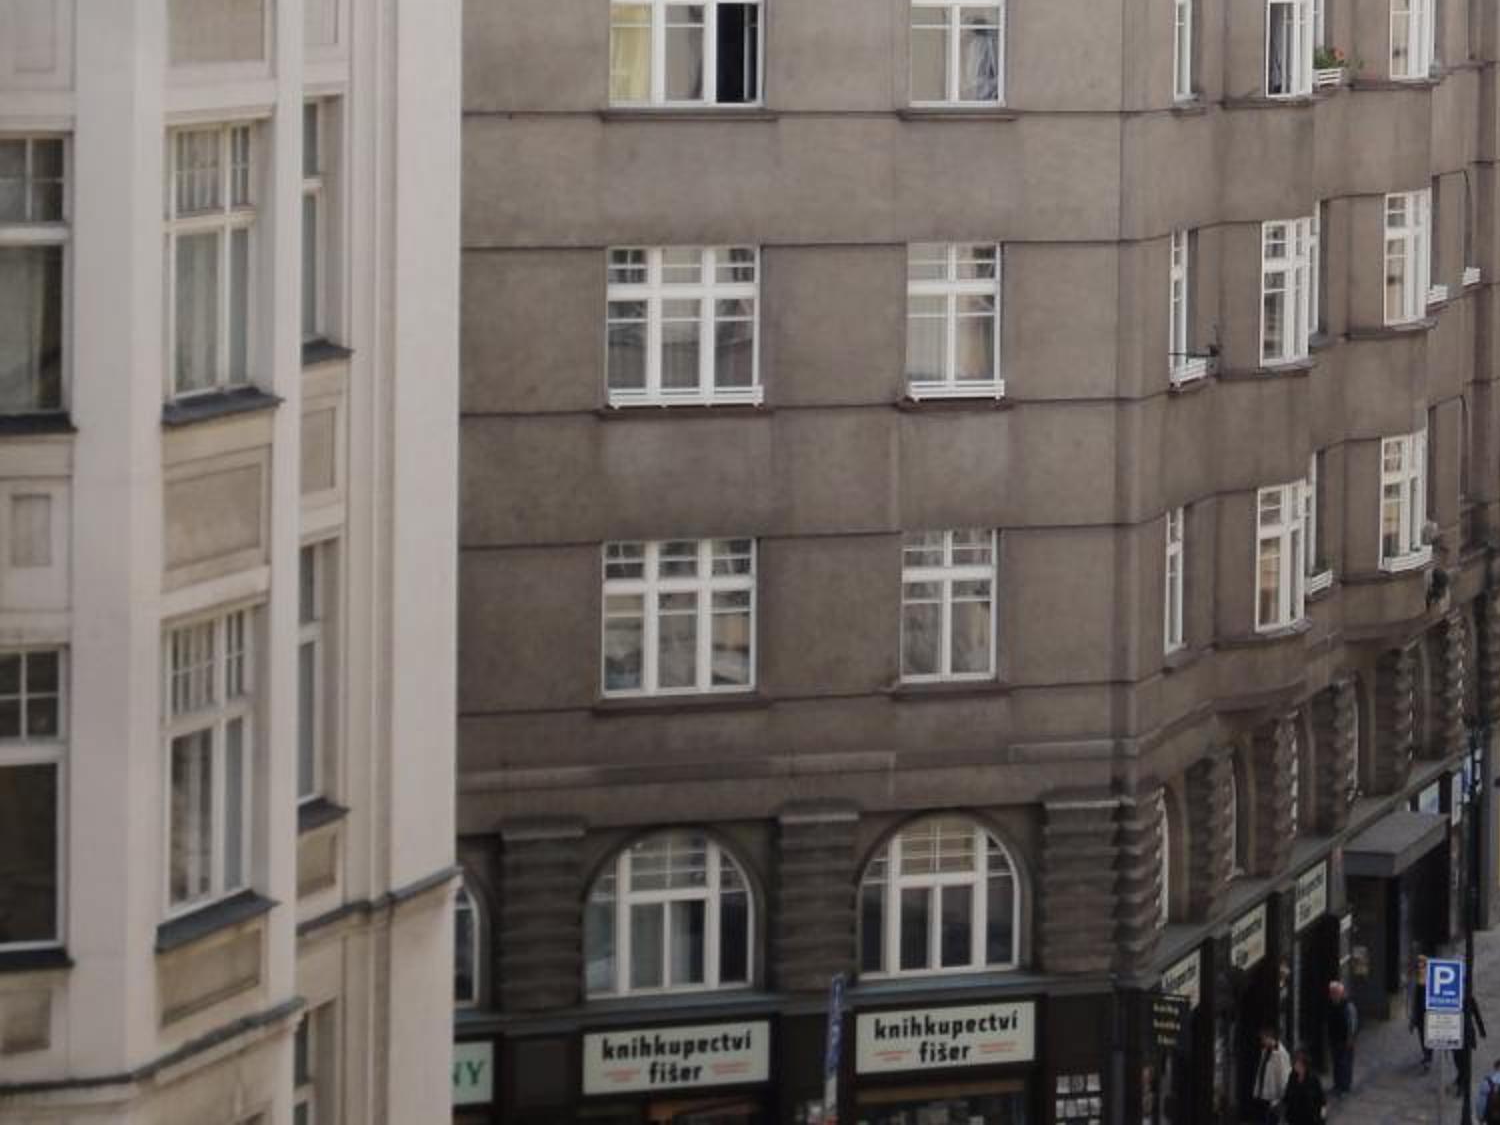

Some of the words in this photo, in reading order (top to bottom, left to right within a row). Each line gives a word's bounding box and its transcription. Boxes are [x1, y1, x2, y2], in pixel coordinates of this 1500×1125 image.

[1433, 966, 1456, 995] P
[873, 1010, 1018, 1041] knihkupectví
[602, 1030, 752, 1060] knihkupectví
[918, 1040, 971, 1063] fišer
[648, 1061, 703, 1084] fišer
